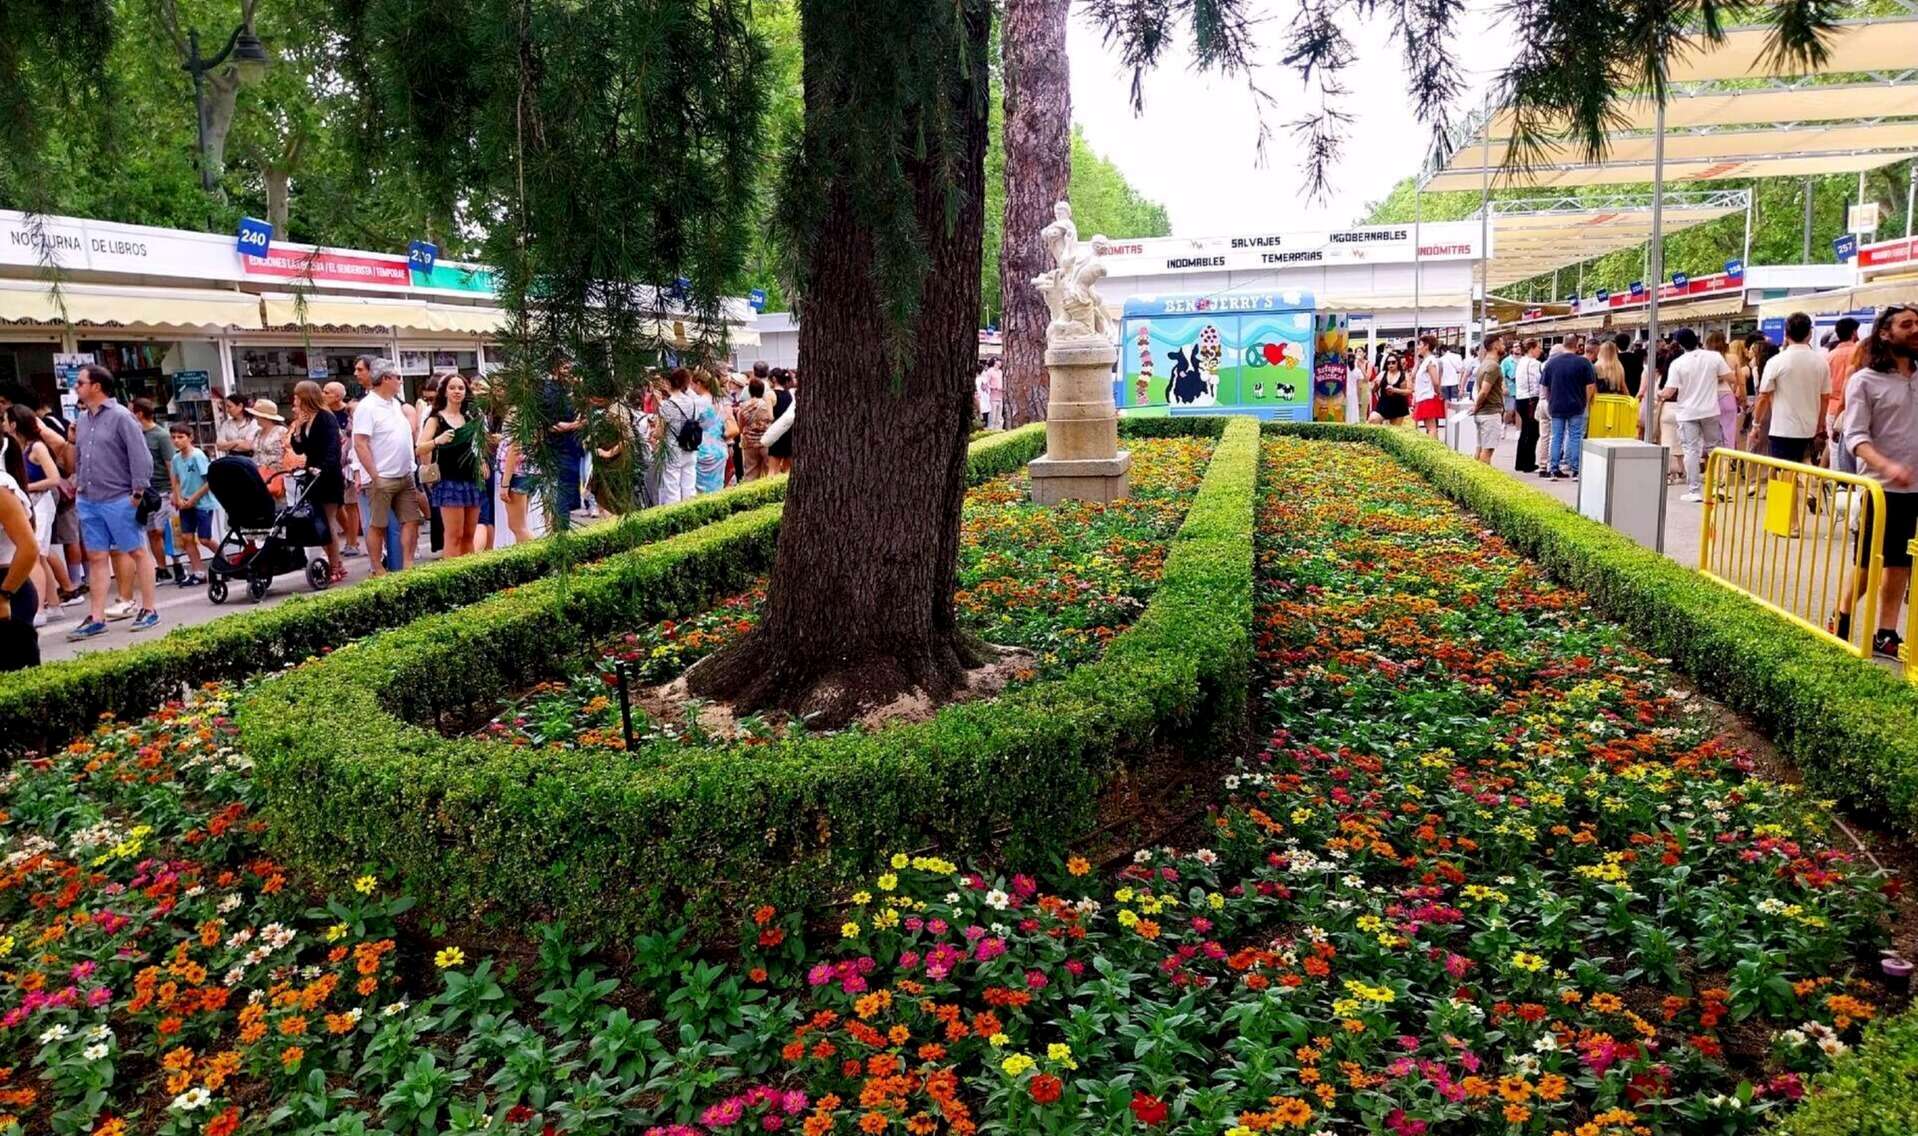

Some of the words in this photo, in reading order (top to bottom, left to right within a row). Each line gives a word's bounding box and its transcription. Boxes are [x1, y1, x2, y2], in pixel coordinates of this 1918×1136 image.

[241, 229, 266, 246] 240
[1231, 236, 1281, 249] SALVAJES
[1329, 230, 1407, 243] INGOBERNABLES
[92, 239, 107, 253] DE
[109, 240, 147, 256] LIBROS
[1837, 241, 1853, 254] 257
[1166, 256, 1225, 269] INDOMABLES
[1261, 251, 1323, 263] TEMERARIAS
[1165, 299, 1195, 312] BEN
[1210, 295, 1273, 311] JERRY'S
